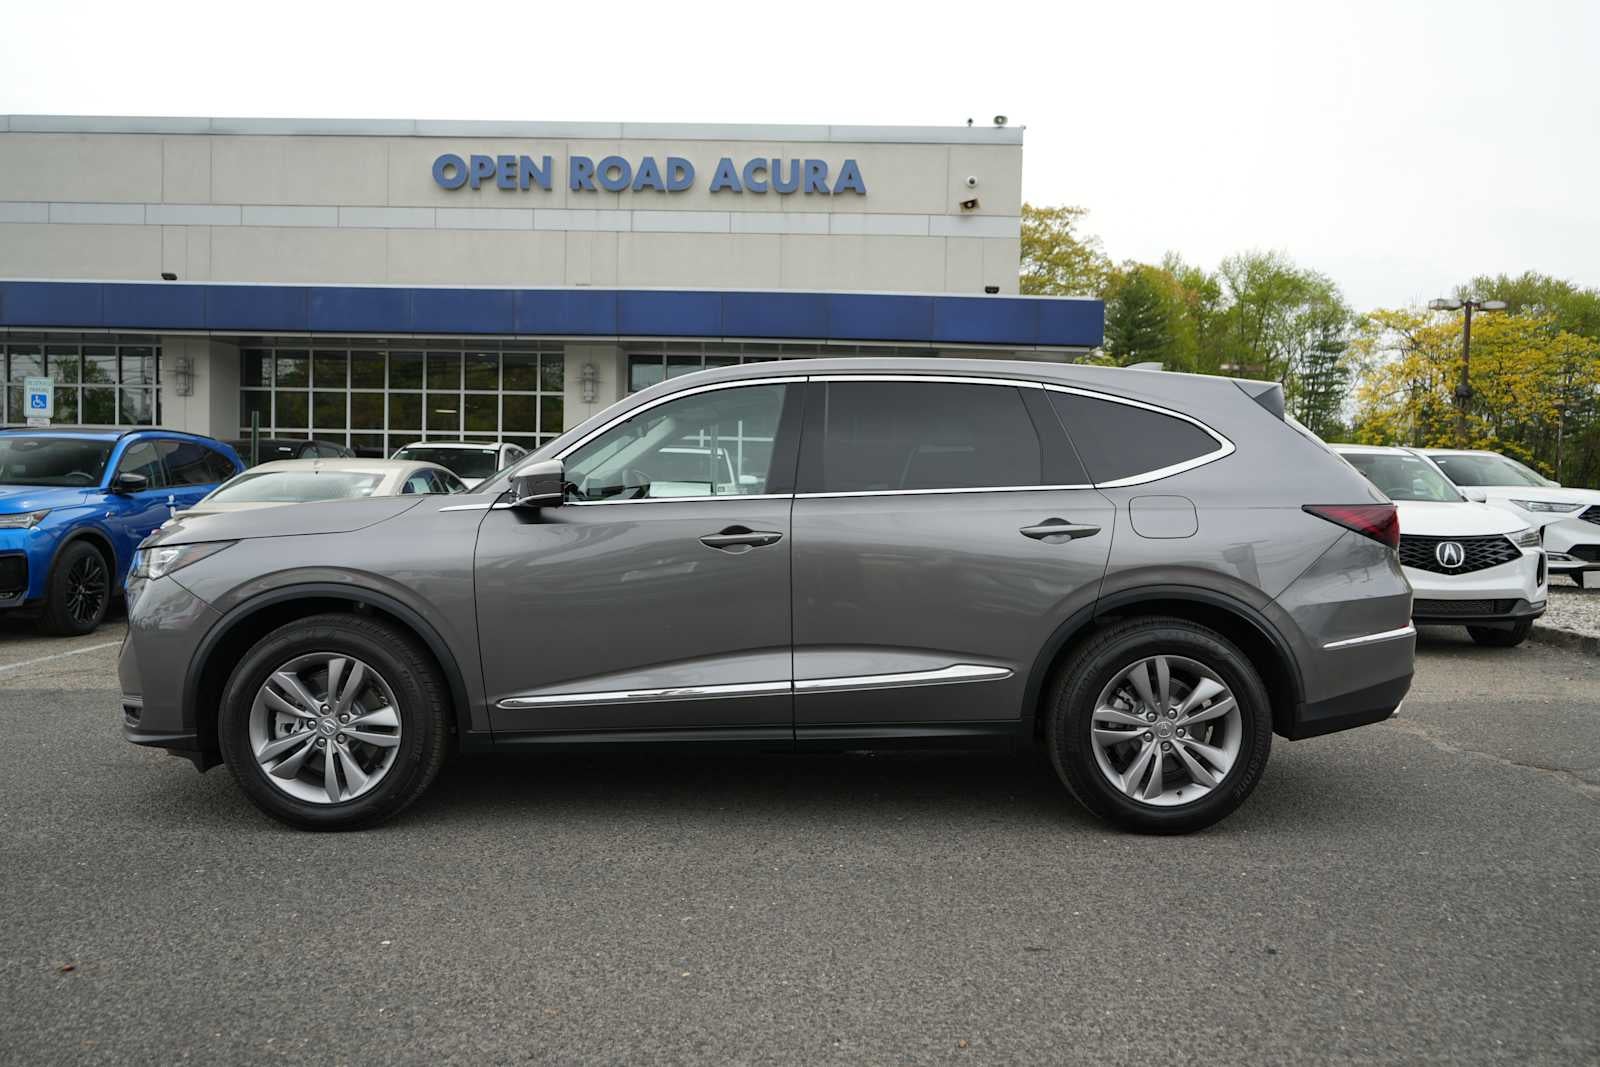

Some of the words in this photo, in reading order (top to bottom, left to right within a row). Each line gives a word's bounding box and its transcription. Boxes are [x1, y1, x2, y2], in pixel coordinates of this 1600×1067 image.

[432, 153, 553, 192] OPEN
[569, 155, 696, 193] ROAD
[709, 157, 867, 195] ACURA
